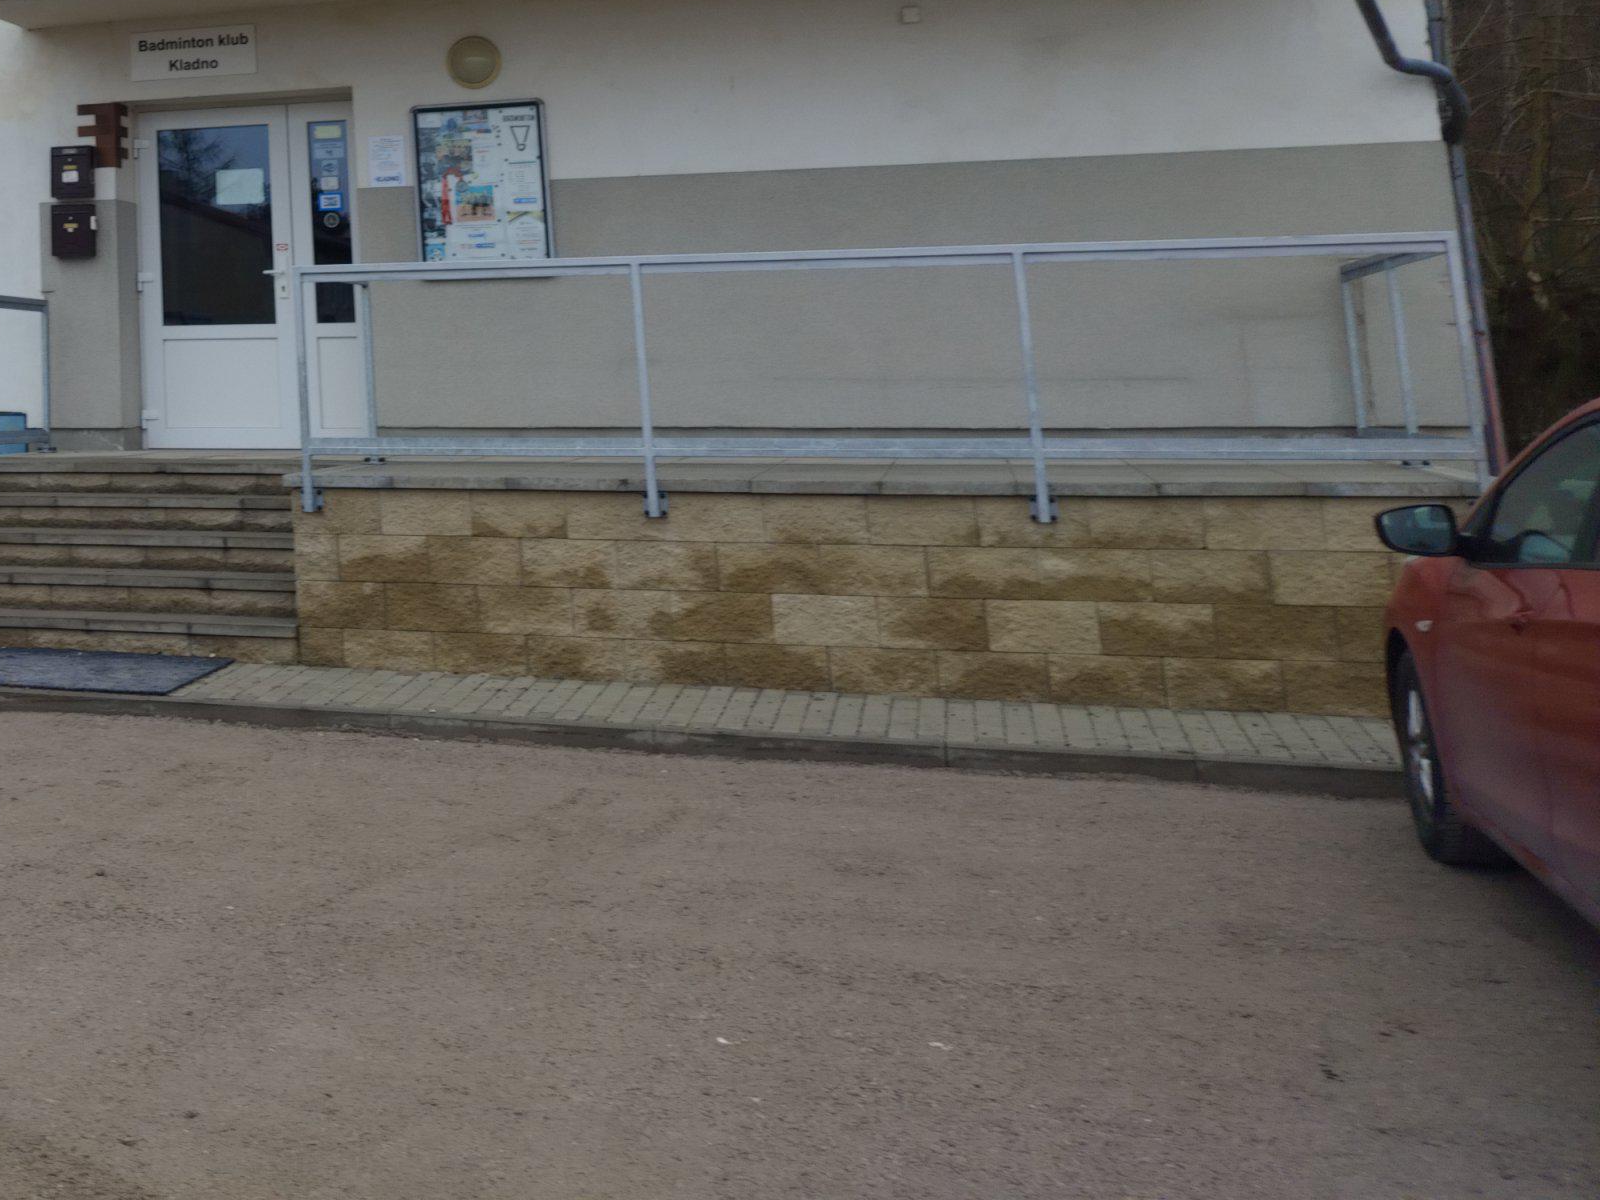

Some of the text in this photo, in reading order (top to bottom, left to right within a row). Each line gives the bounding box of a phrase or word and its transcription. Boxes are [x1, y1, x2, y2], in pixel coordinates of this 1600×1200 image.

[138, 33, 249, 52] Badminton klub
[168, 58, 219, 71] Kladno
